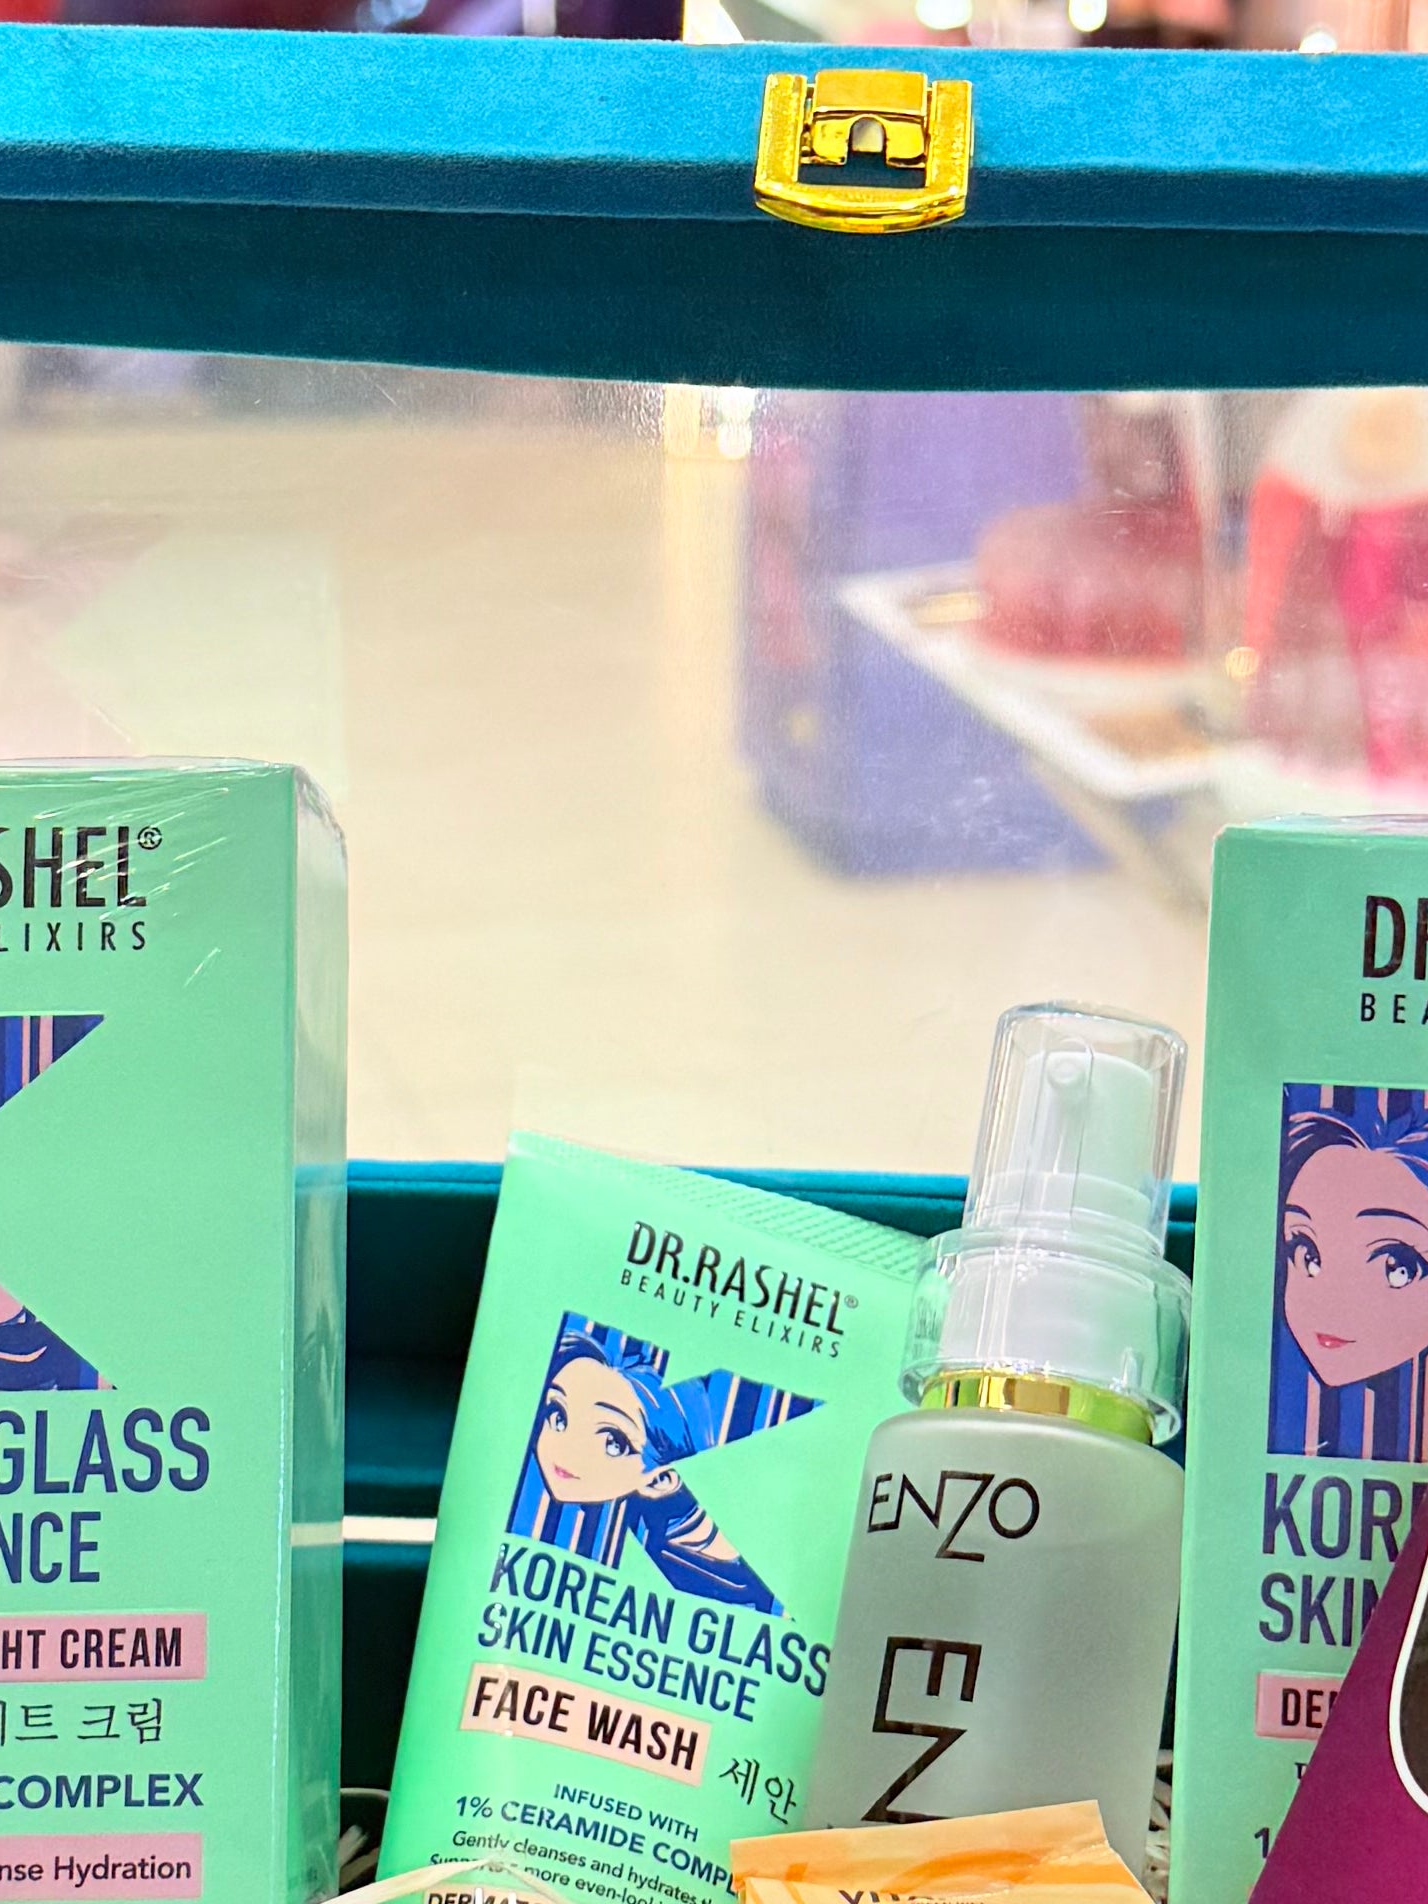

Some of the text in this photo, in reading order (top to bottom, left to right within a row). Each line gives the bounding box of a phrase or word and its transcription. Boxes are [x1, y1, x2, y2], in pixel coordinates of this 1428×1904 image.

[621, 1268, 841, 1360] BEAUTY ELIXIRS
[867, 1469, 1040, 1563] ENZO
[59, 1626, 183, 1669] CREAM
[489, 1541, 832, 1698] KOREAN GLASS
[478, 1601, 762, 1723] SKIN ESSENCE
[77, 1696, 165, 1745] 크림
[473, 1675, 699, 1771] FACE WASH
[554, 1782, 700, 1843] INFUSED WITH
[719, 1756, 799, 1827] 세안
[455, 1795, 493, 1822] 1%
[501, 1800, 646, 1855] CERAMIDE
[513, 1836, 587, 1869] cleanses
[590, 1856, 625, 1879] and
[54, 1853, 193, 1888] Hydration
